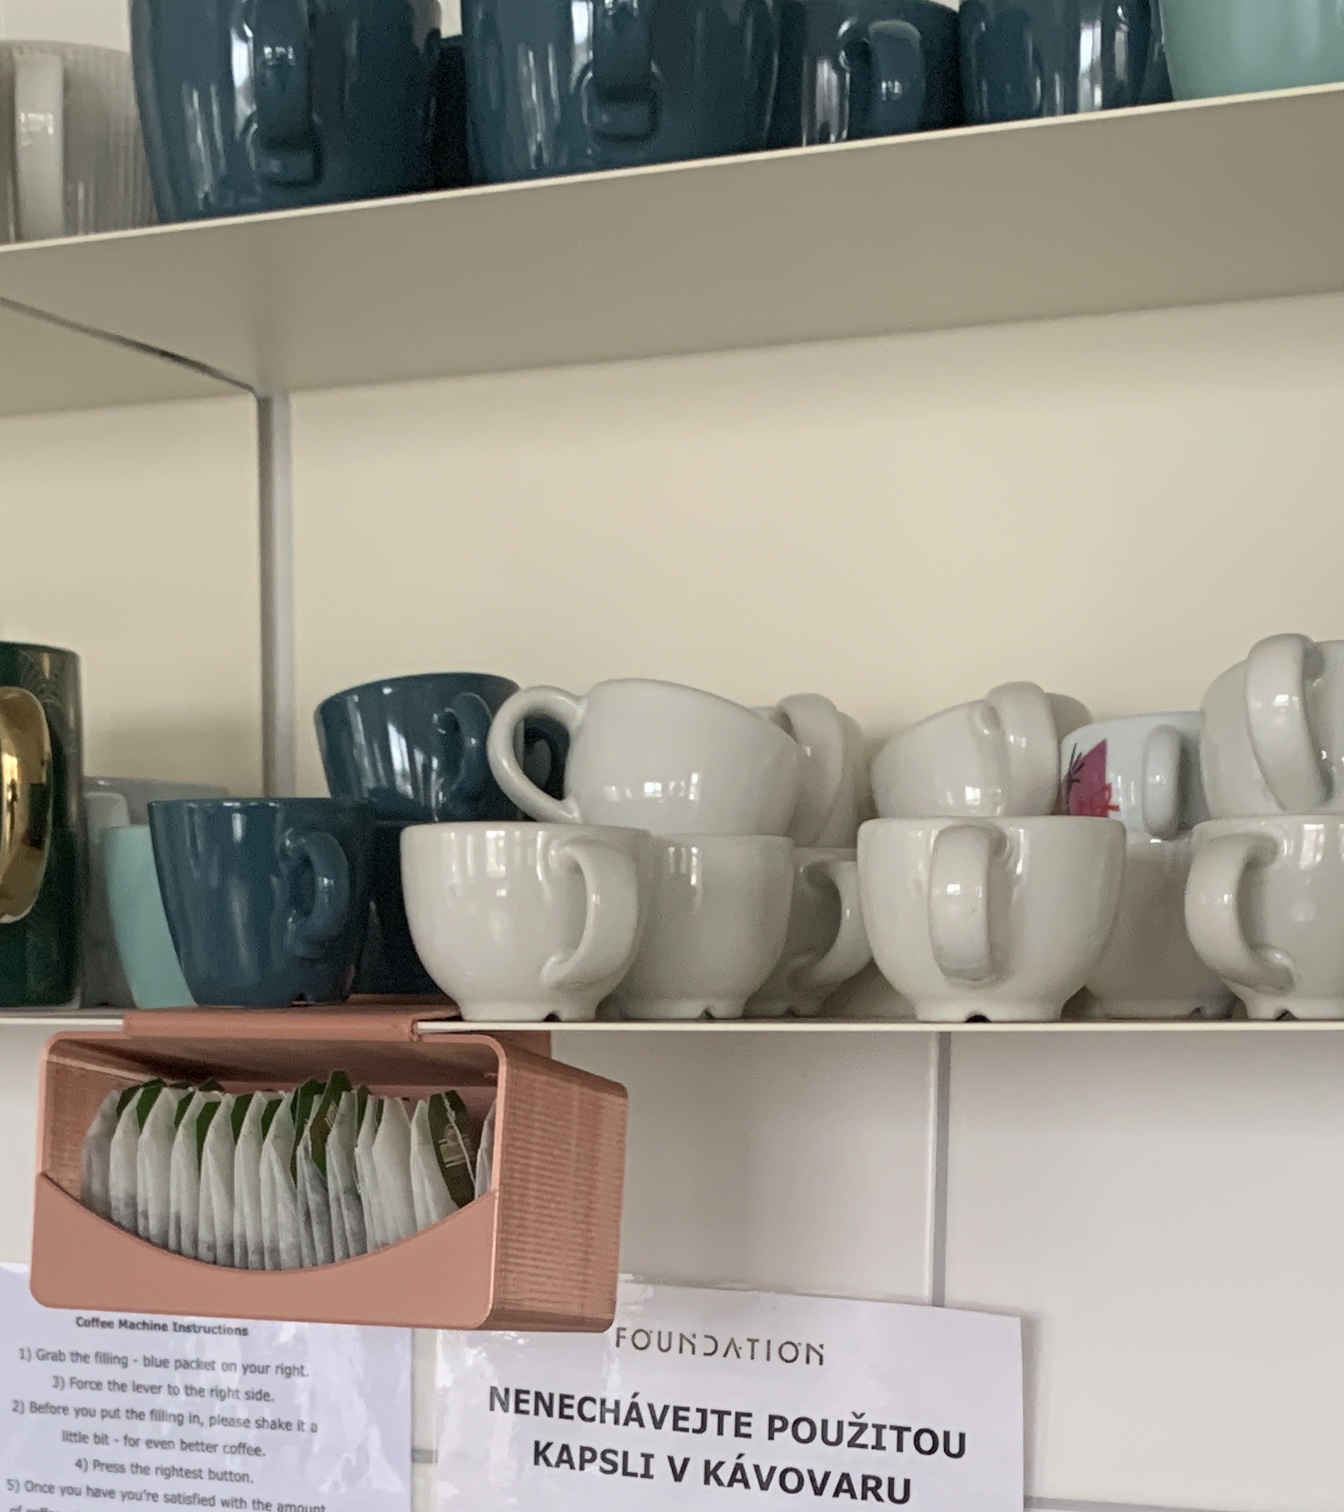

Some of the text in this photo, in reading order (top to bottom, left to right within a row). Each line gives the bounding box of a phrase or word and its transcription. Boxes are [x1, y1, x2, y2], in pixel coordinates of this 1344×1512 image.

[75, 1316, 250, 1336] Coffee Machine Instructions
[615, 1327, 825, 1366] FOUNDATION
[18, 1347, 309, 1380] 1) Grab the filling blue packet on your right.
[53, 1375, 275, 1403] 3) Force the lever to the right side.
[12, 1399, 319, 1434] 2) Before you put the filling in, please shake it a
[489, 1386, 966, 1459] NENECHÁVEJTE POUŽITOU
[61, 1429, 267, 1457] little bit for even better coffee.
[75, 1458, 254, 1484] 4) Press the rightest button.
[533, 1440, 911, 1505] KAPSLI V KÁVOVARU
[6, 1478, 21, 1494] 5)
[24, 1480, 56, 1494] Once
[59, 1486, 83, 1498] you
[86, 1485, 117, 1499] have
[120, 1489, 160, 1504] you're
[163, 1493, 217, 1508] satisfied
[220, 1497, 248, 1510] with
[252, 1498, 274, 1512] the
